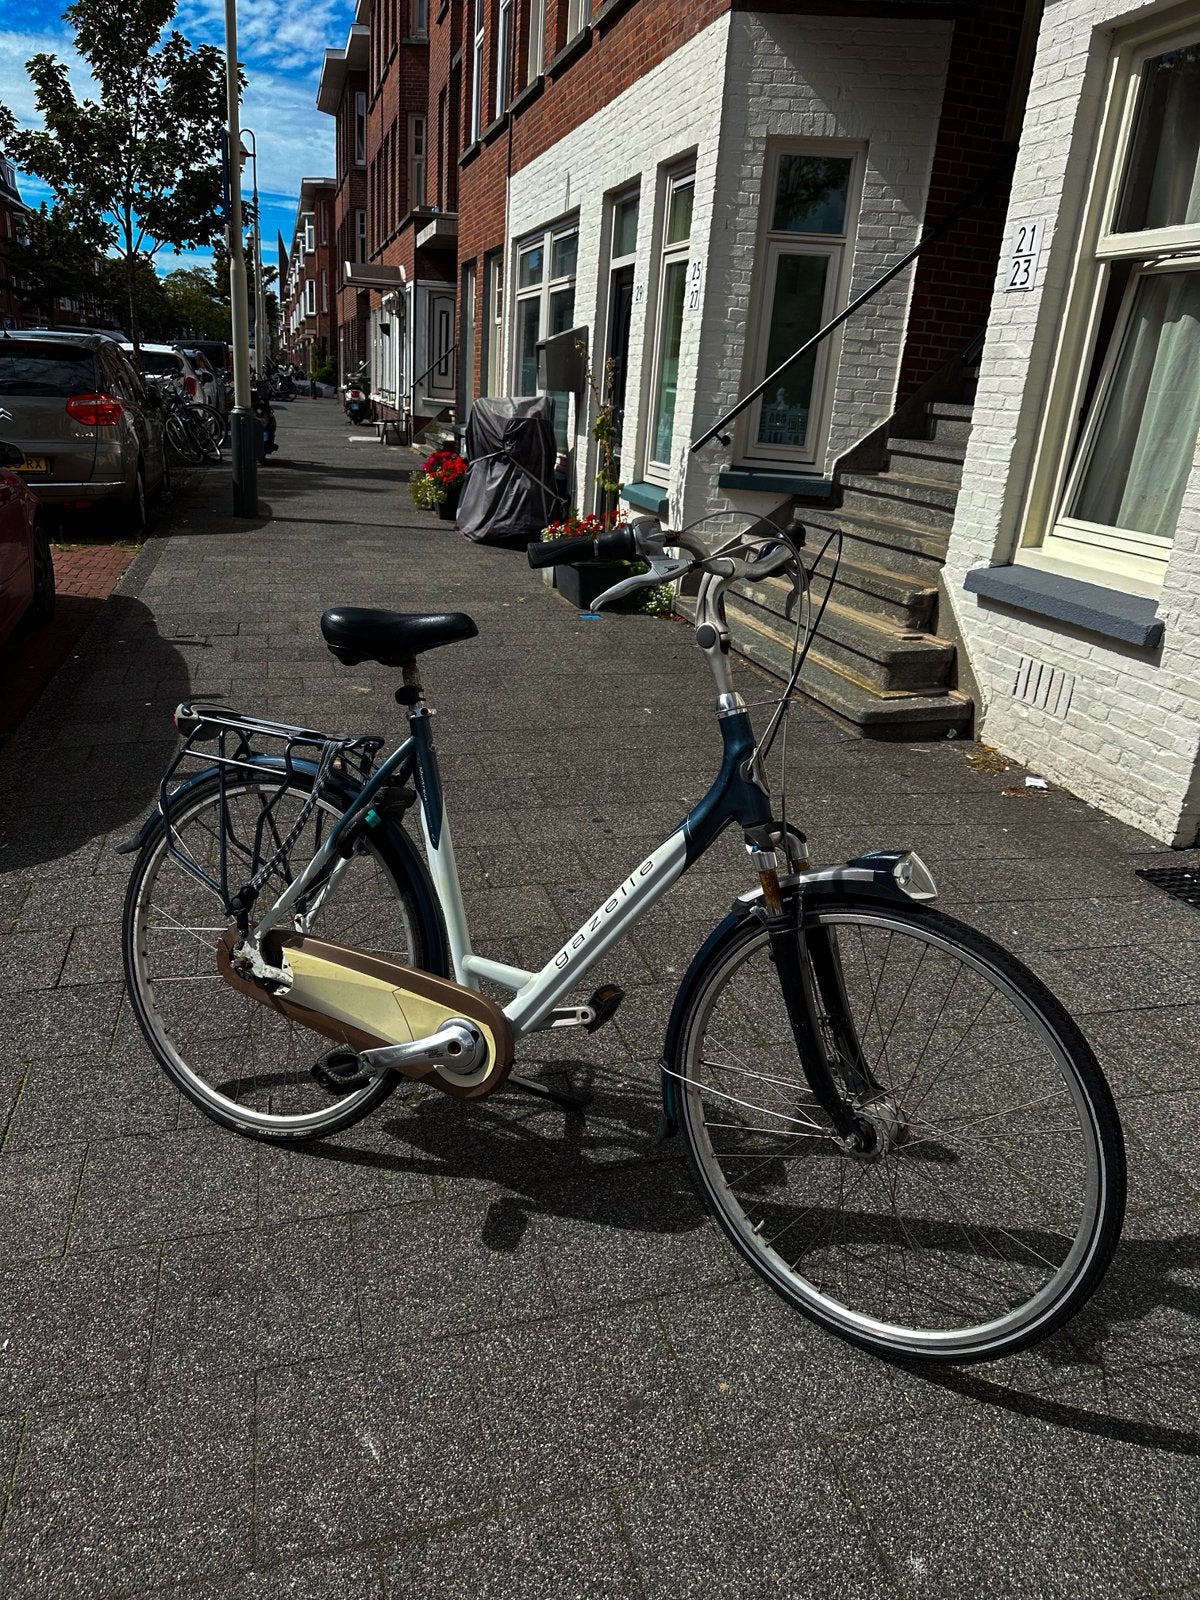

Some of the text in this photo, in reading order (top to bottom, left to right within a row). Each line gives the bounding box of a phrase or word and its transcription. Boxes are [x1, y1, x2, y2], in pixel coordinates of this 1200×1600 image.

[1015, 225, 1036, 253] 21
[692, 261, 701, 280] 25
[1009, 259, 1031, 286] 23
[635, 285, 643, 301] 29
[689, 290, 699, 308] 27
[555, 860, 653, 969] gazelle
